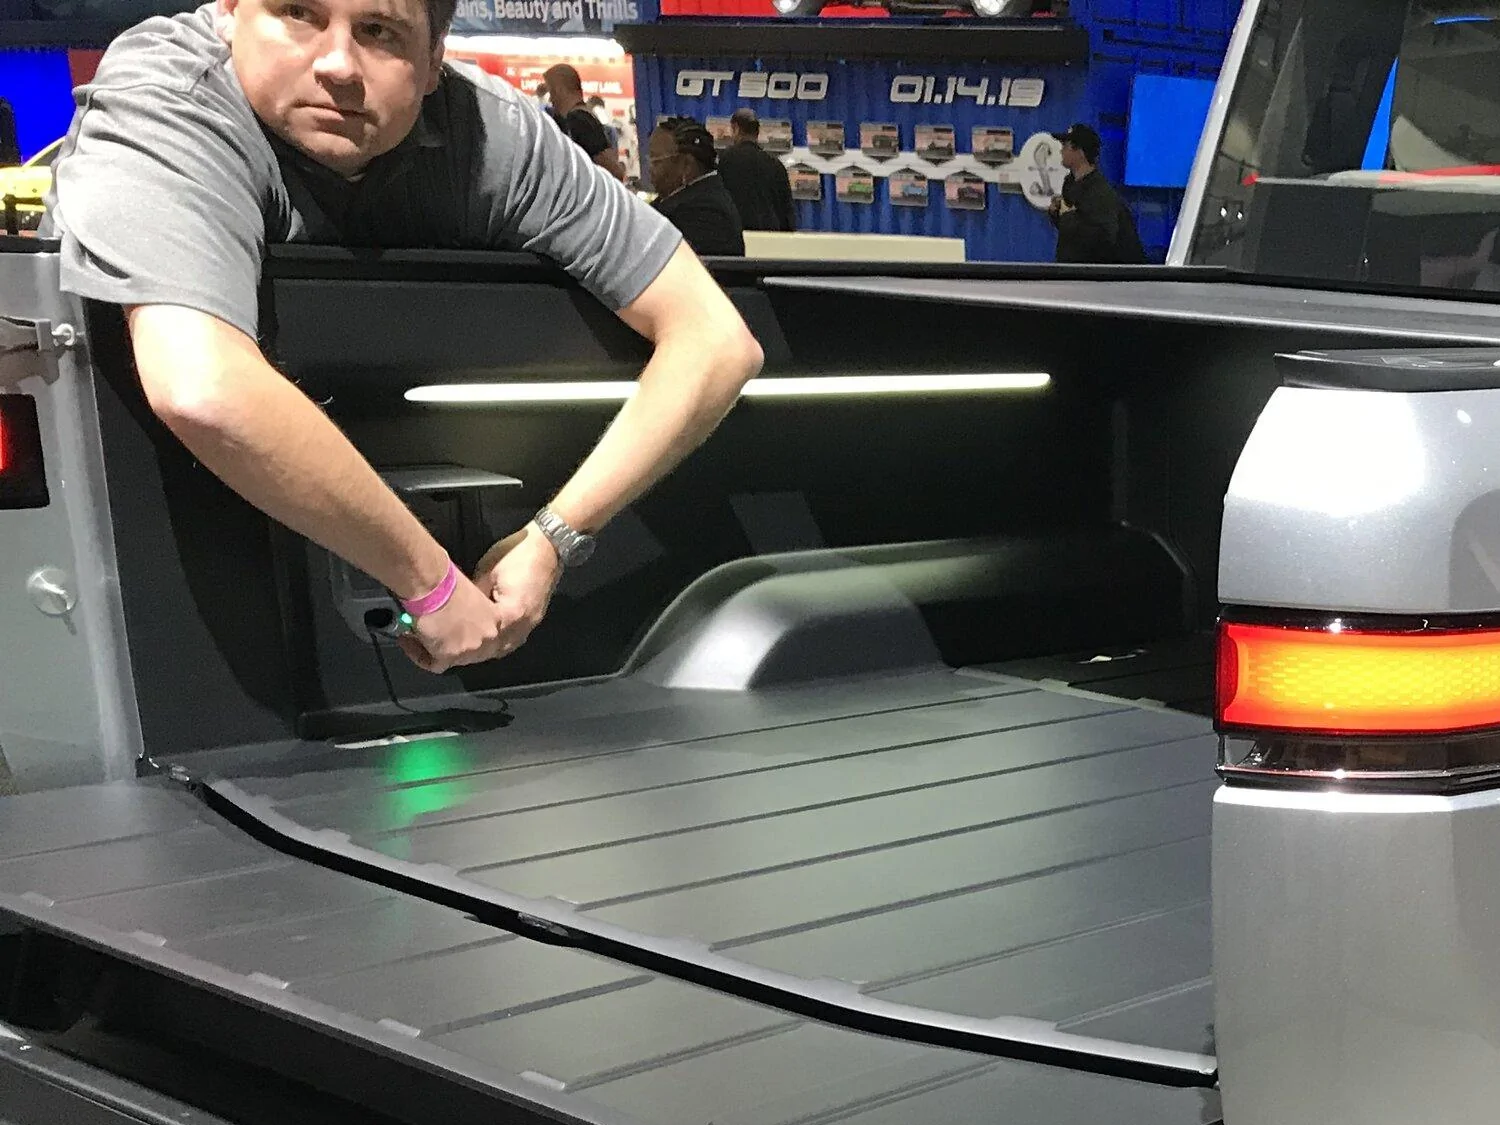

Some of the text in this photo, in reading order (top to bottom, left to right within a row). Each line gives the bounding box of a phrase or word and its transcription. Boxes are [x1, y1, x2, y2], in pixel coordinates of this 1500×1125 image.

[456, 0, 638, 23] ains, Beauty and Thrills
[676, 70, 829, 100] GT 500
[889, 75, 1045, 107] 01.14.19
